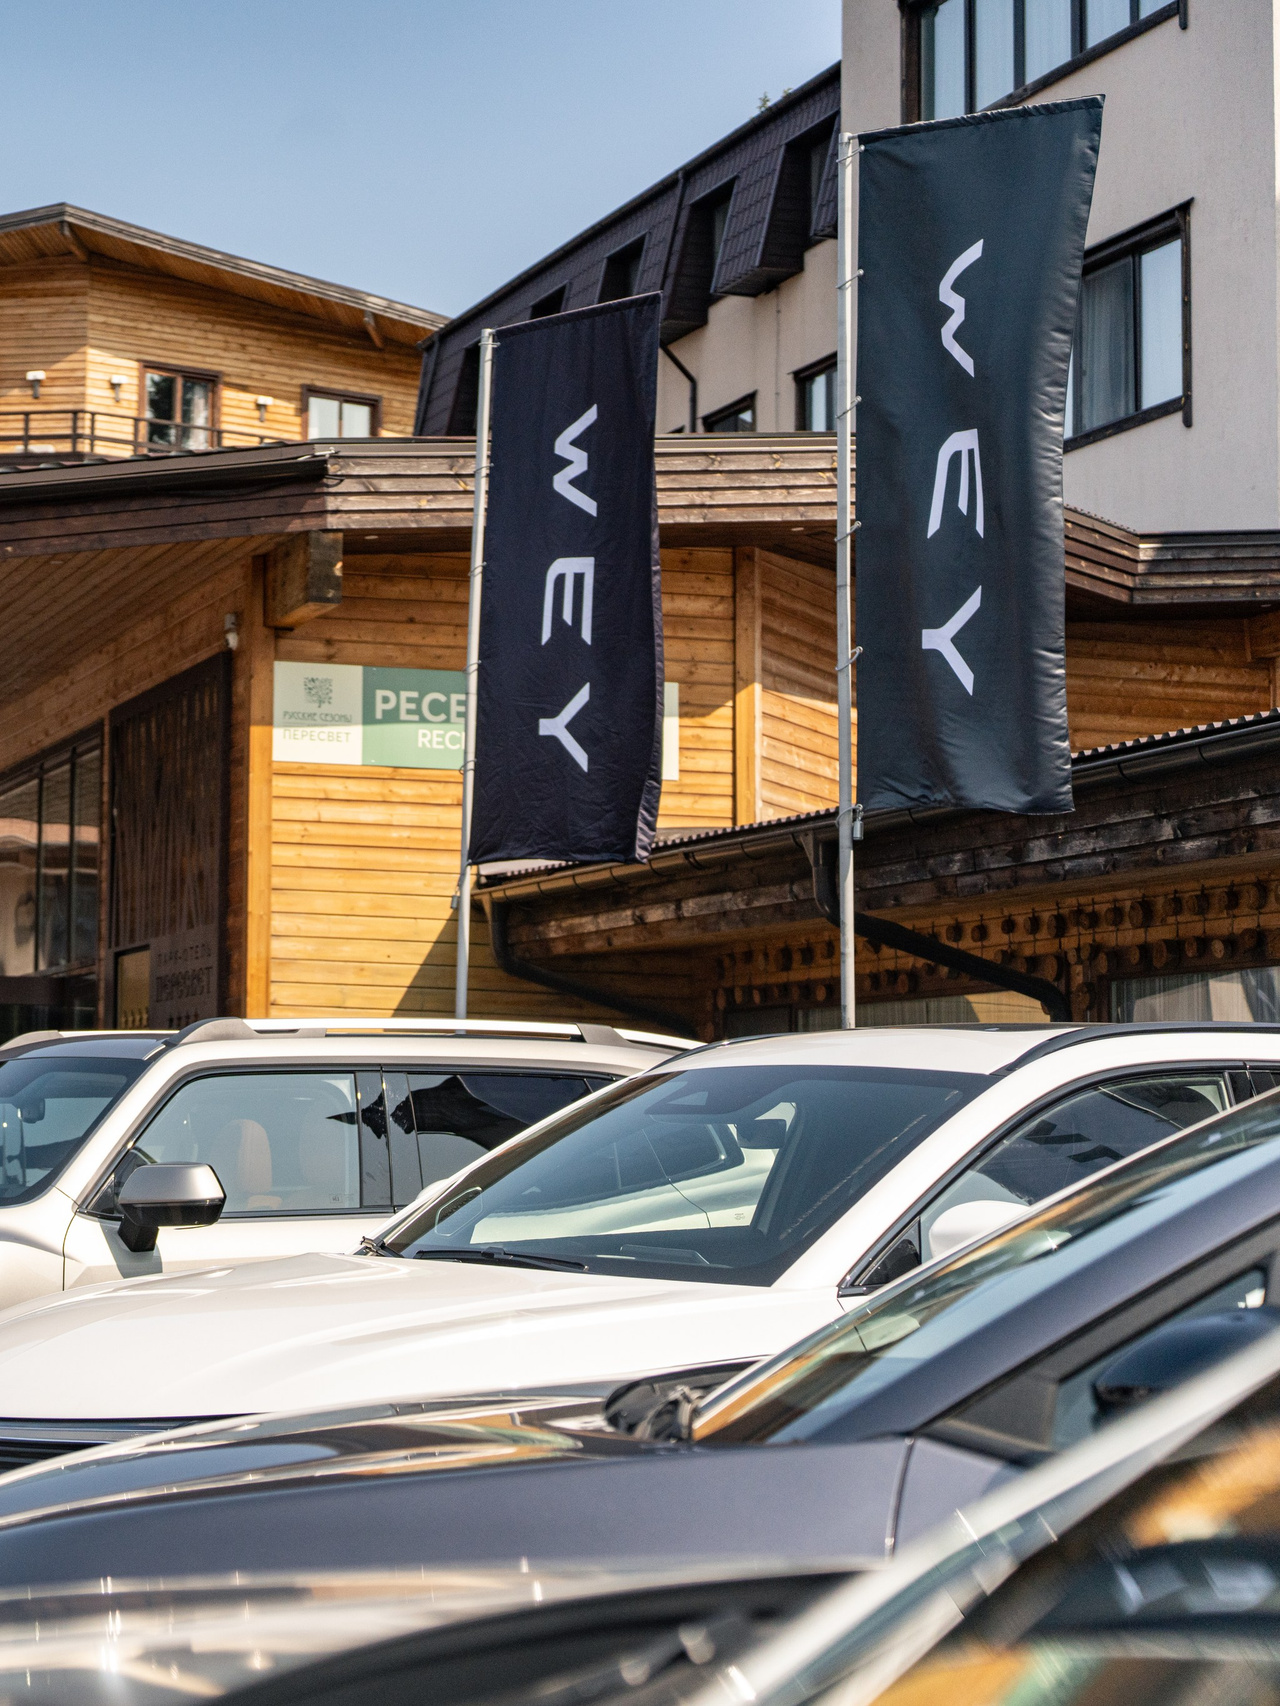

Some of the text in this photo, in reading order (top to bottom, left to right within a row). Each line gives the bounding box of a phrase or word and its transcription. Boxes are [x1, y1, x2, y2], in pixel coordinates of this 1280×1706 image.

[921, 238, 984, 697] WEY
[538, 403, 599, 773] WEY
[282, 710, 352, 724] РУССКИЕ СЕЗОНЫ
[282, 728, 352, 743] ПЕРЕСВЕТ
[417, 728, 466, 750] REC
